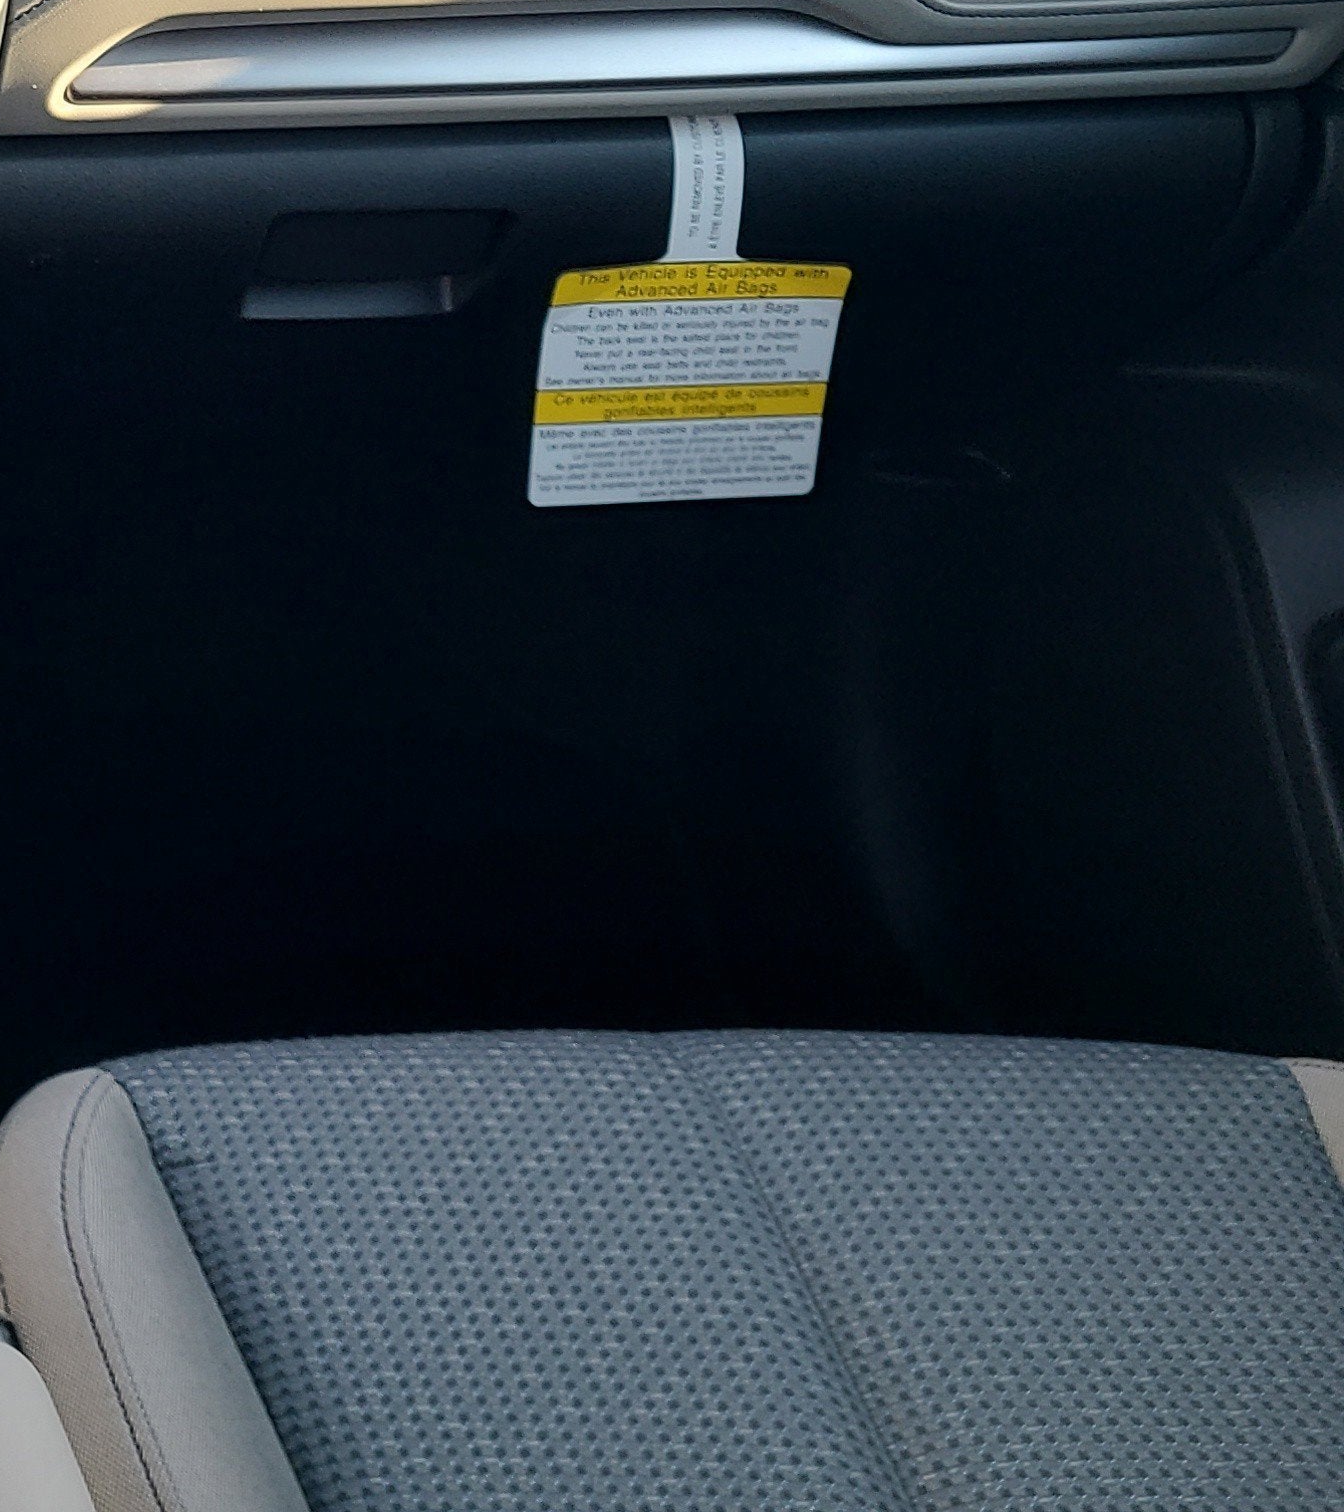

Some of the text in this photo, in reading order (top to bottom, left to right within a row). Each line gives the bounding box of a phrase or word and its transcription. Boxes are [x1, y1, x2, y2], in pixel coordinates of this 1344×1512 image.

[619, 268, 678, 281] Vehicle
[683, 266, 698, 279] is
[706, 265, 786, 281] Equipped
[615, 282, 699, 299] Advanced
[736, 280, 777, 297] Bags
